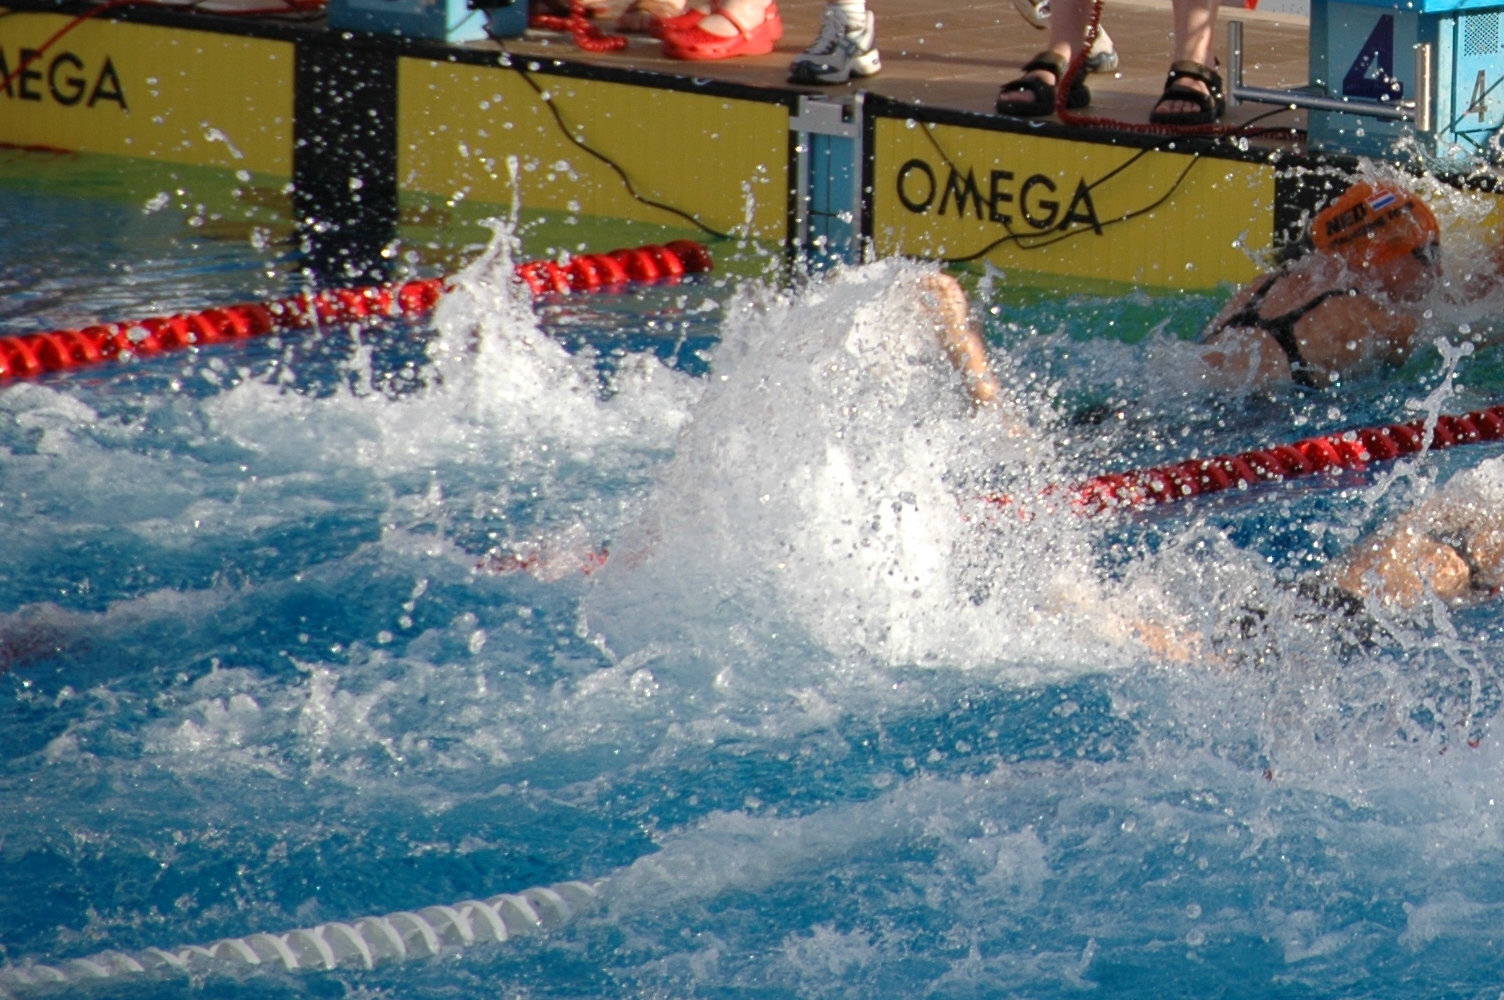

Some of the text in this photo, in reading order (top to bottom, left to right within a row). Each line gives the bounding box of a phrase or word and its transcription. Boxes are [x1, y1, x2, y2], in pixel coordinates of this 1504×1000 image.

[1343, 14, 1403, 122] 4
[1466, 70, 1487, 122] 4
[896, 158, 1103, 236] OMEGA
[1326, 202, 1367, 237] NED
